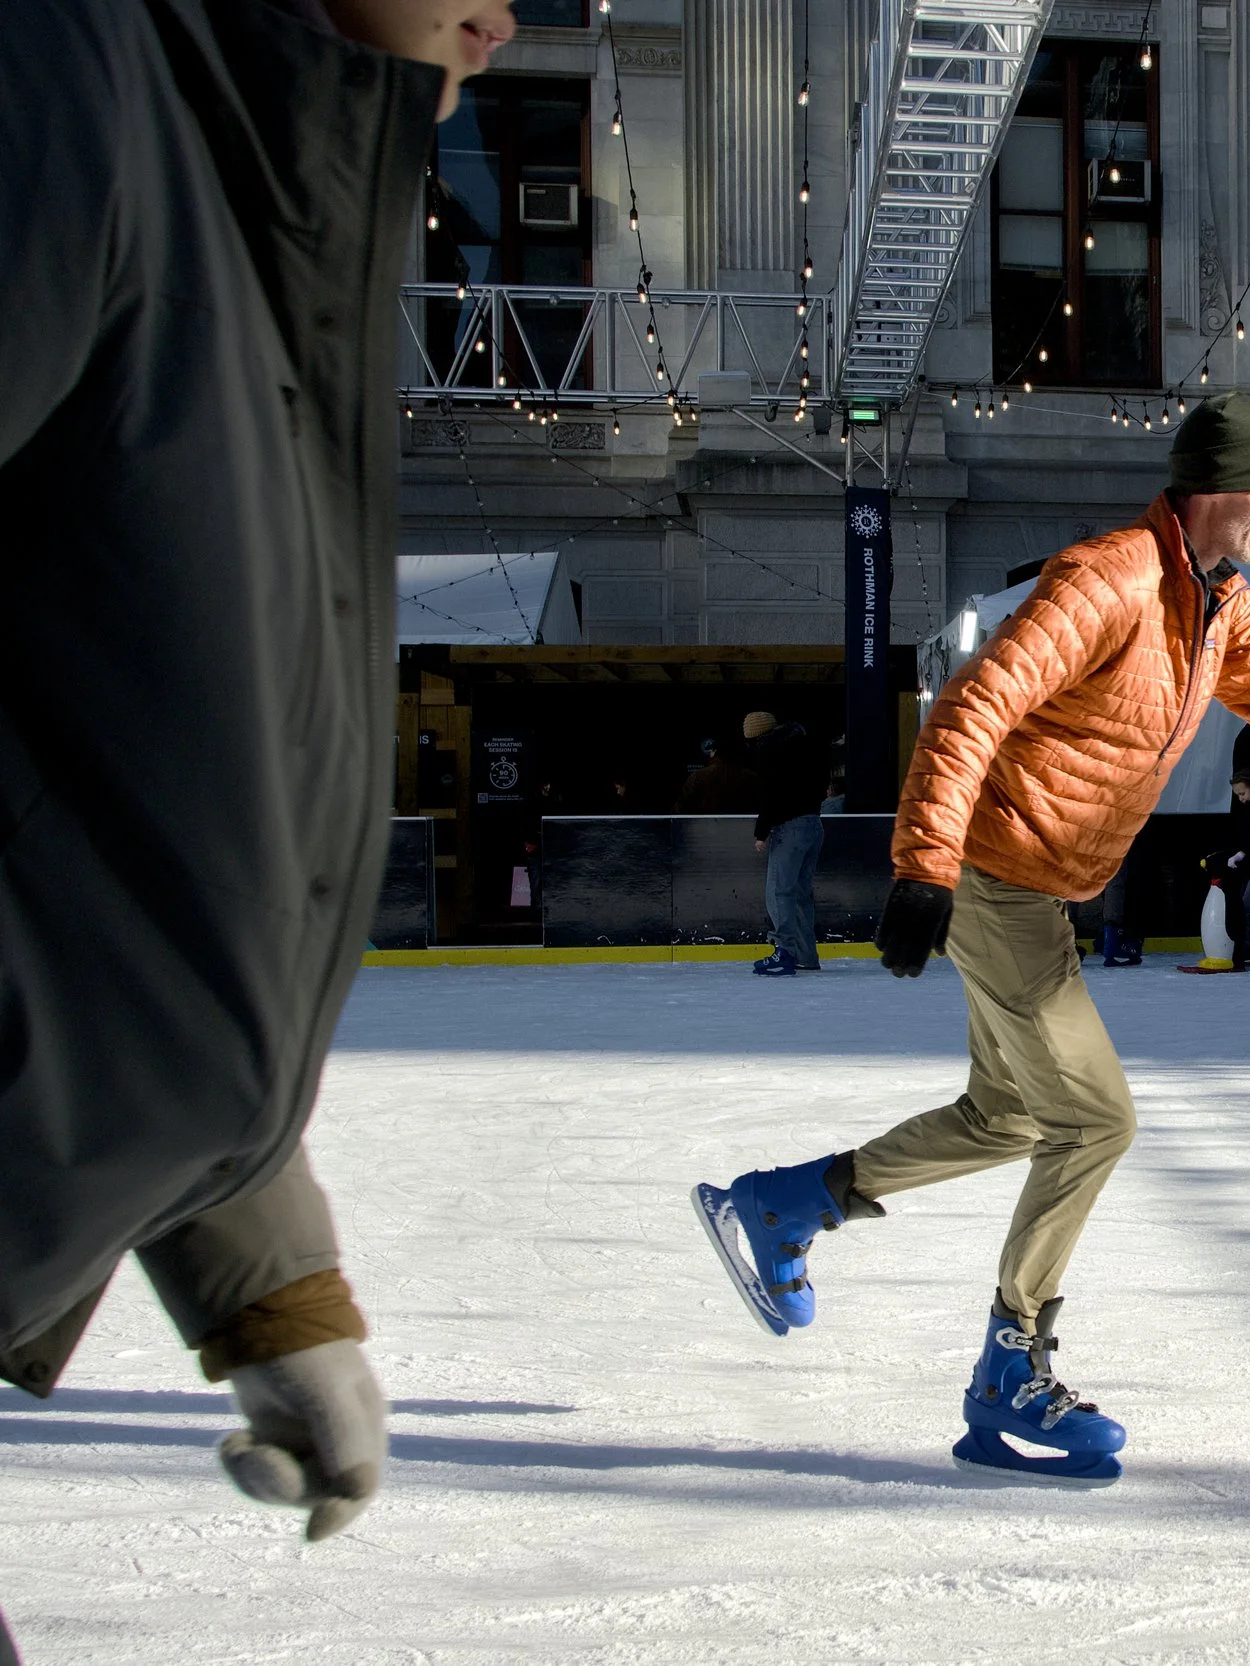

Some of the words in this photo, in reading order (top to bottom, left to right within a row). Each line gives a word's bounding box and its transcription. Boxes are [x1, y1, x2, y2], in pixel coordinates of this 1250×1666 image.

[863, 547, 876, 610] ROTHMAN
[864, 613, 875, 634] ICE
[863, 638, 874, 668] RINK
